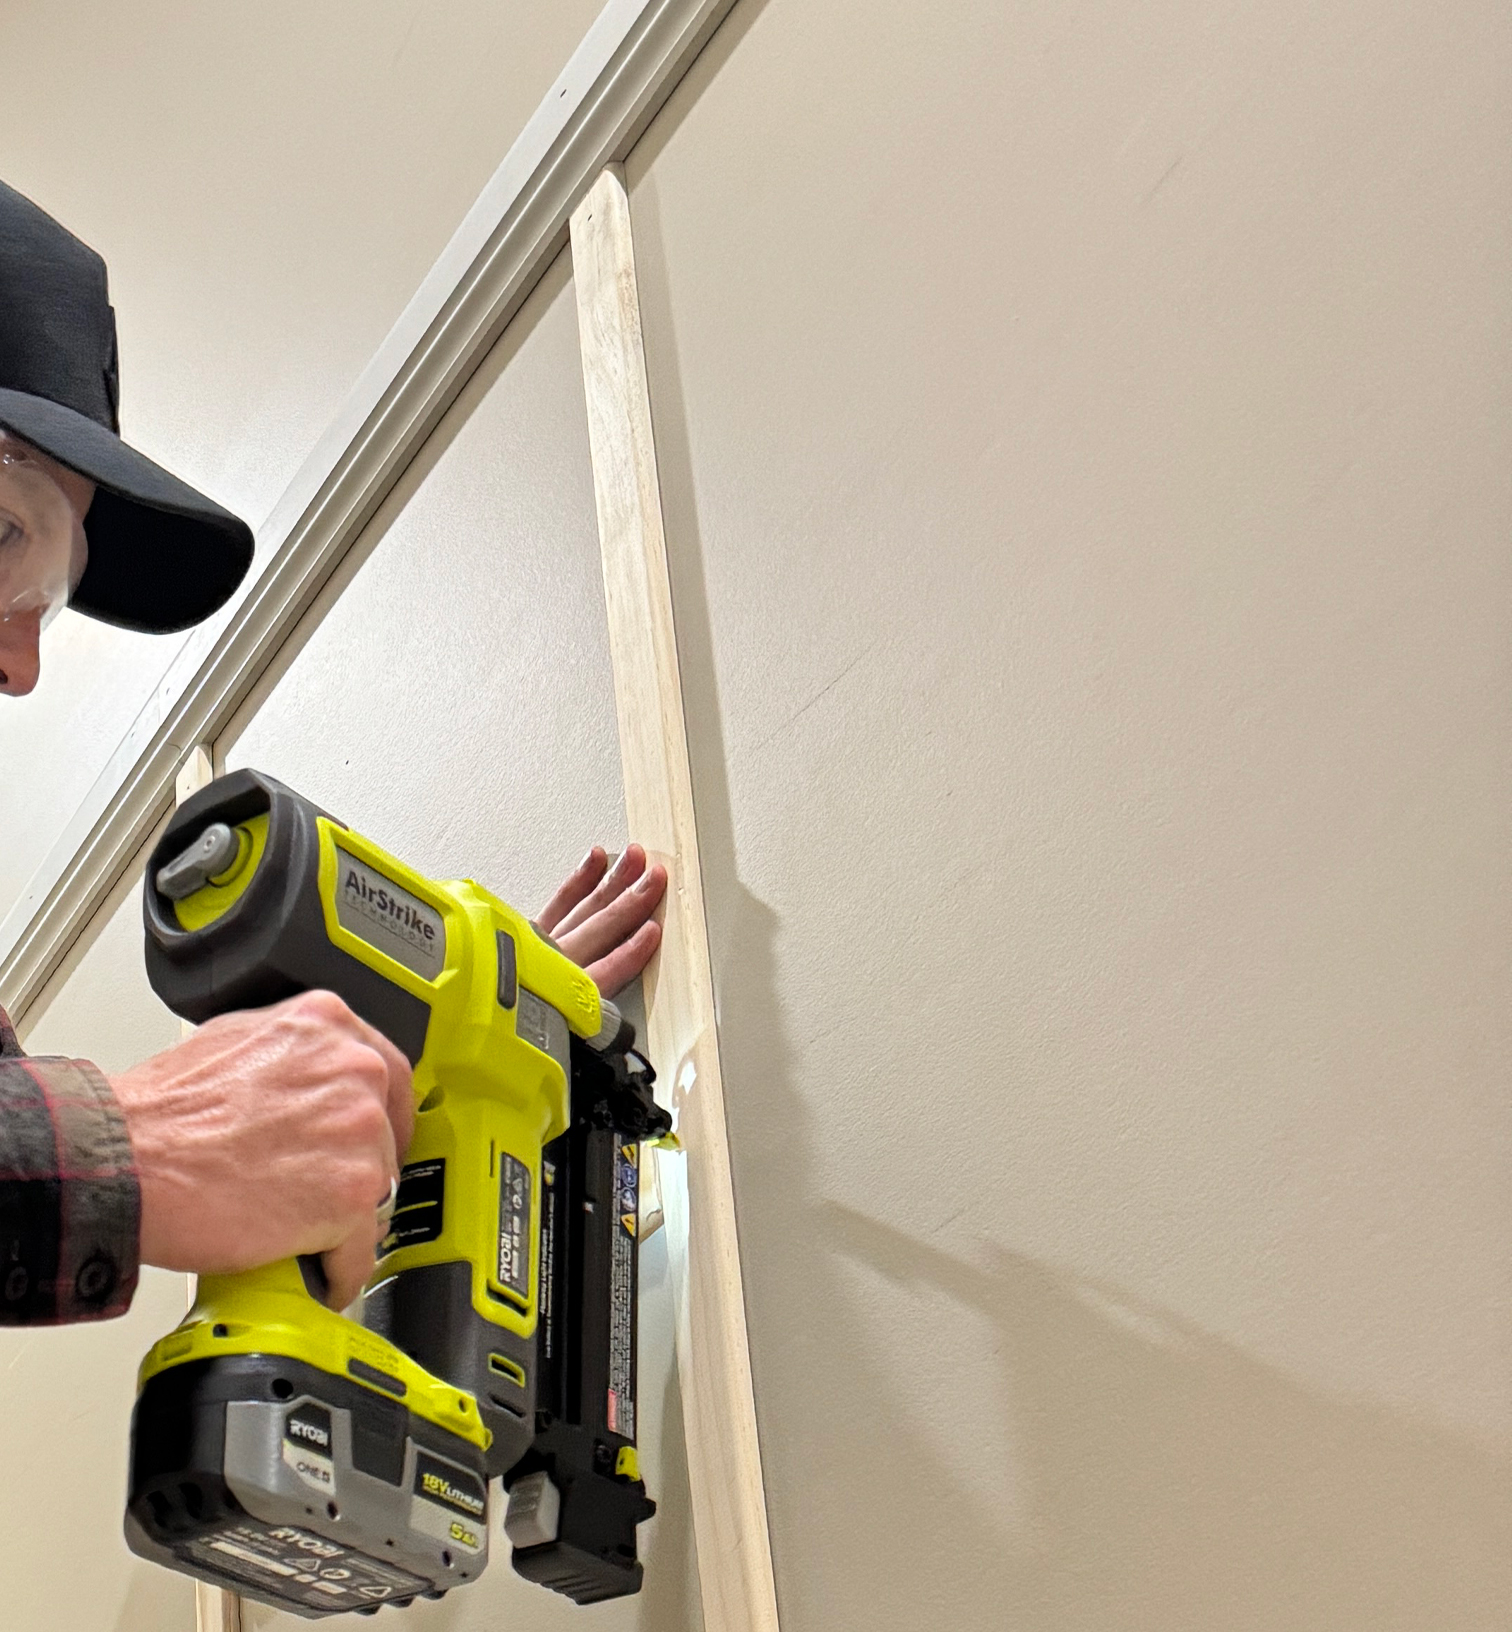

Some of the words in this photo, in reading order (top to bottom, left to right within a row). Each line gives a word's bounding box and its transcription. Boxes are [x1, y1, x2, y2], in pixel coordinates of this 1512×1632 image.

[345, 870, 435, 941] AirStrike
[500, 1231, 512, 1282] RYOBI
[290, 1418, 328, 1447] RYOBI
[423, 1473, 449, 1493] 18V
[269, 1527, 345, 1558] RYOBI
